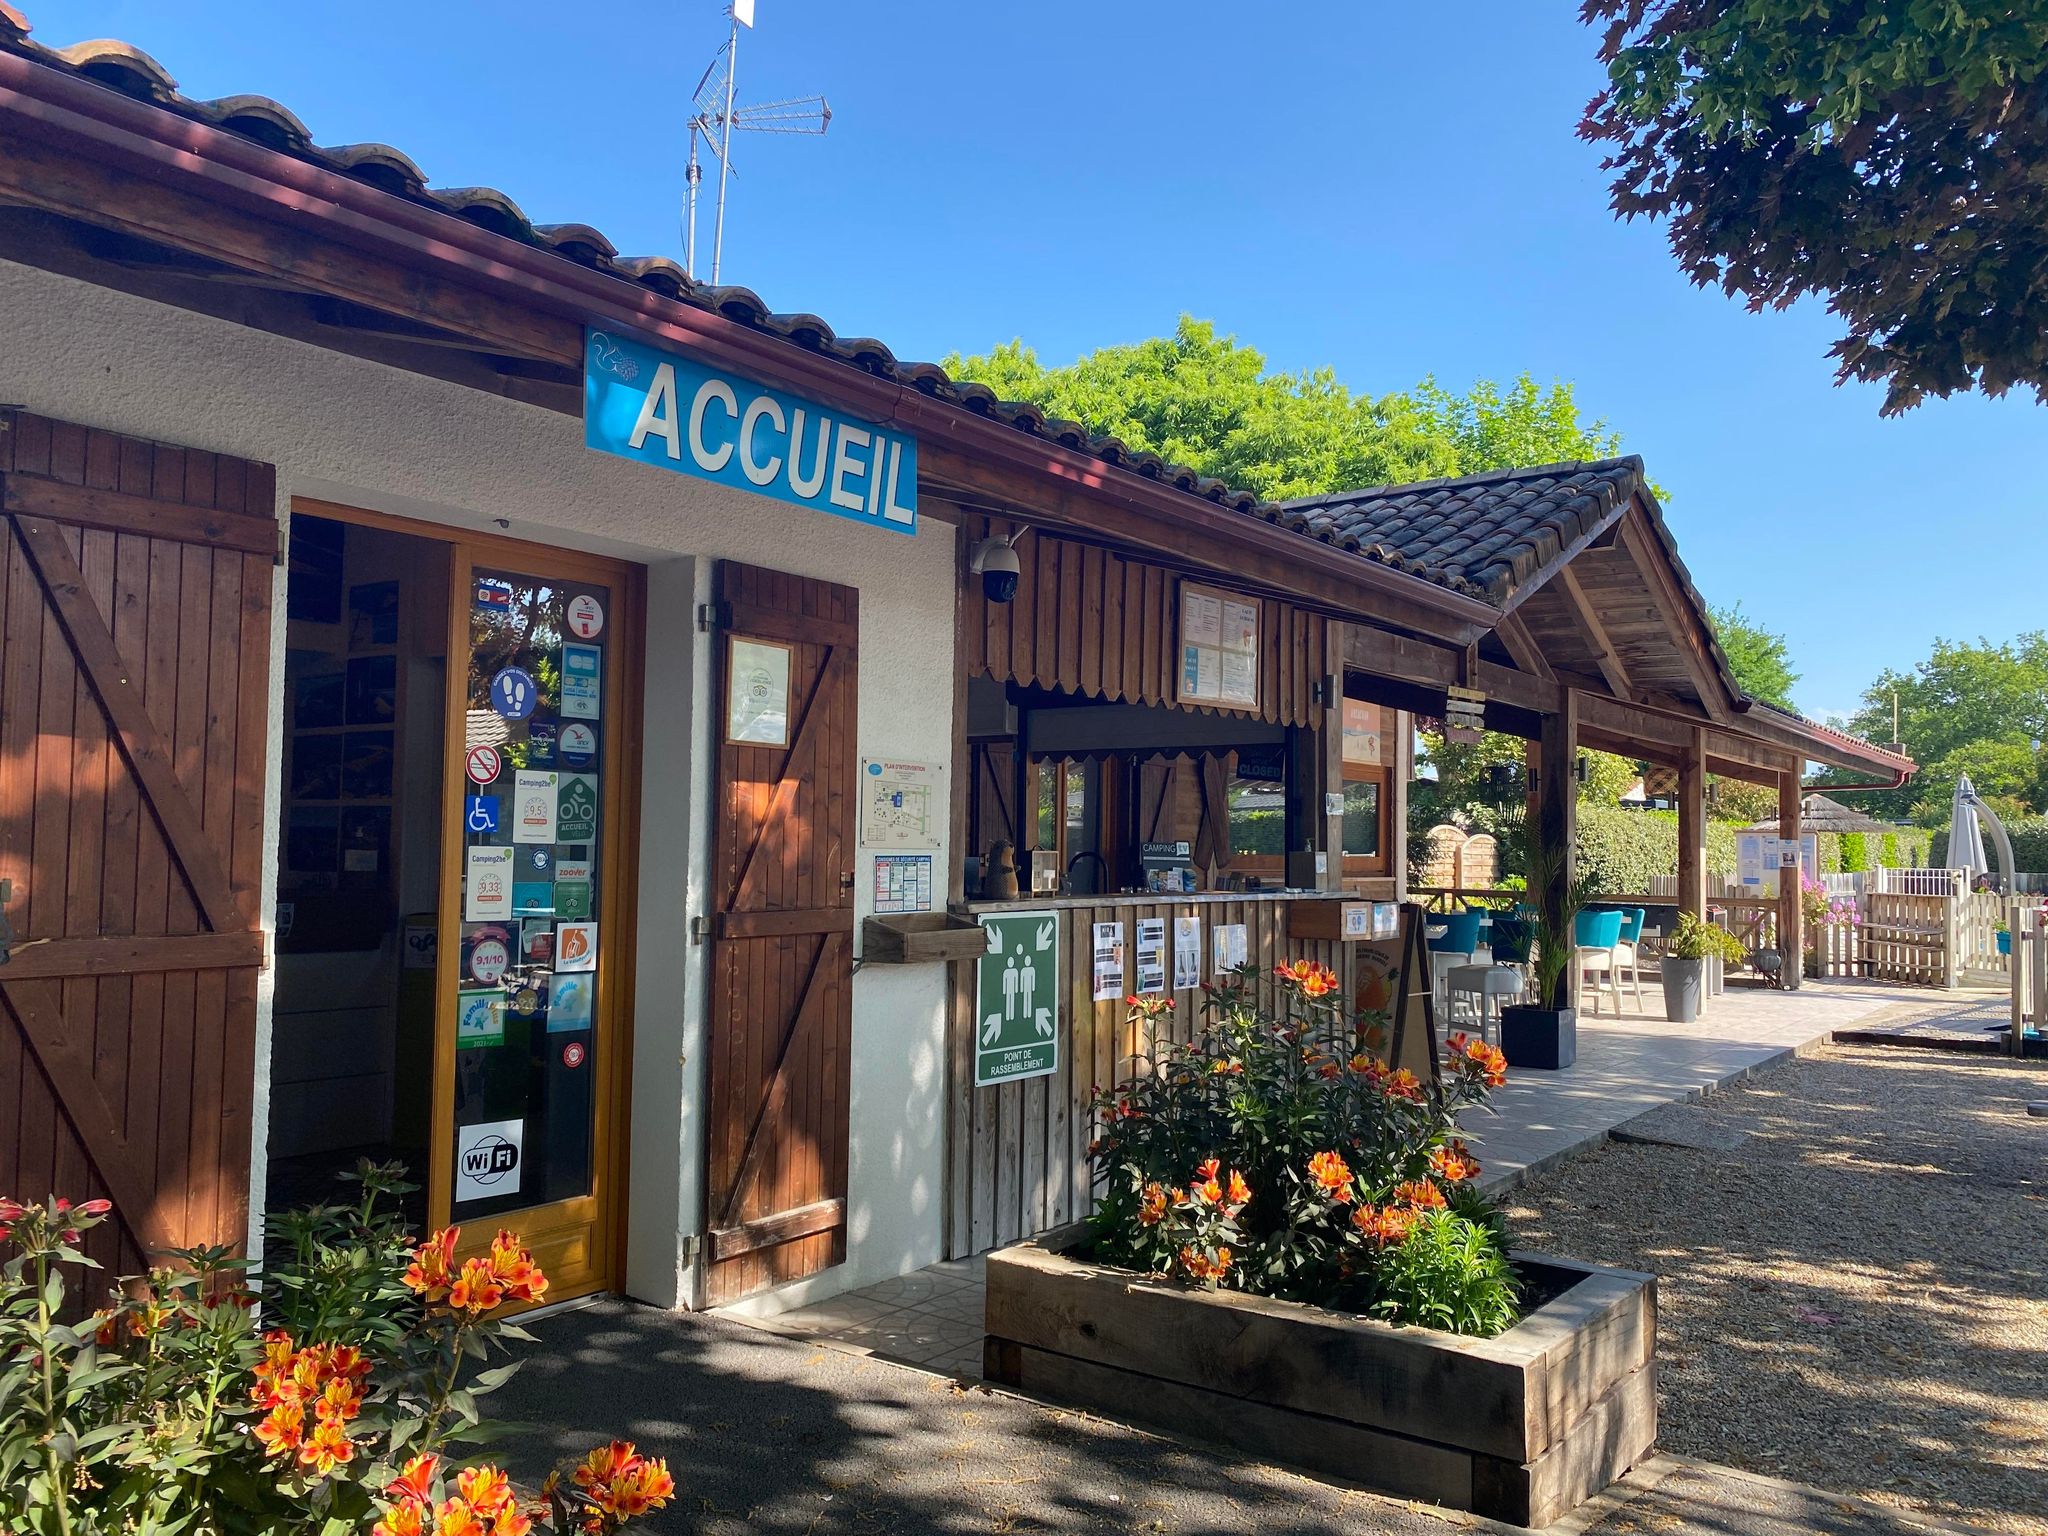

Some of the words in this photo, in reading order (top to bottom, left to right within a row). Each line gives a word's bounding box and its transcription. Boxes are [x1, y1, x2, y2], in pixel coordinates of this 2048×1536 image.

[628, 361, 914, 526] ACCUEIL
[1240, 764, 1281, 778] CLOSED
[518, 778, 551, 788] Camping2be
[561, 823, 589, 831] ACCUEIL
[1142, 843, 1176, 853] CAMPING
[472, 855, 506, 864] Camping2be
[559, 867, 588, 877] zoover
[1004, 1051, 1023, 1063] POINT
[1023, 1049, 1032, 1060] DE
[990, 1057, 1044, 1076] RASSEMBLEMENT
